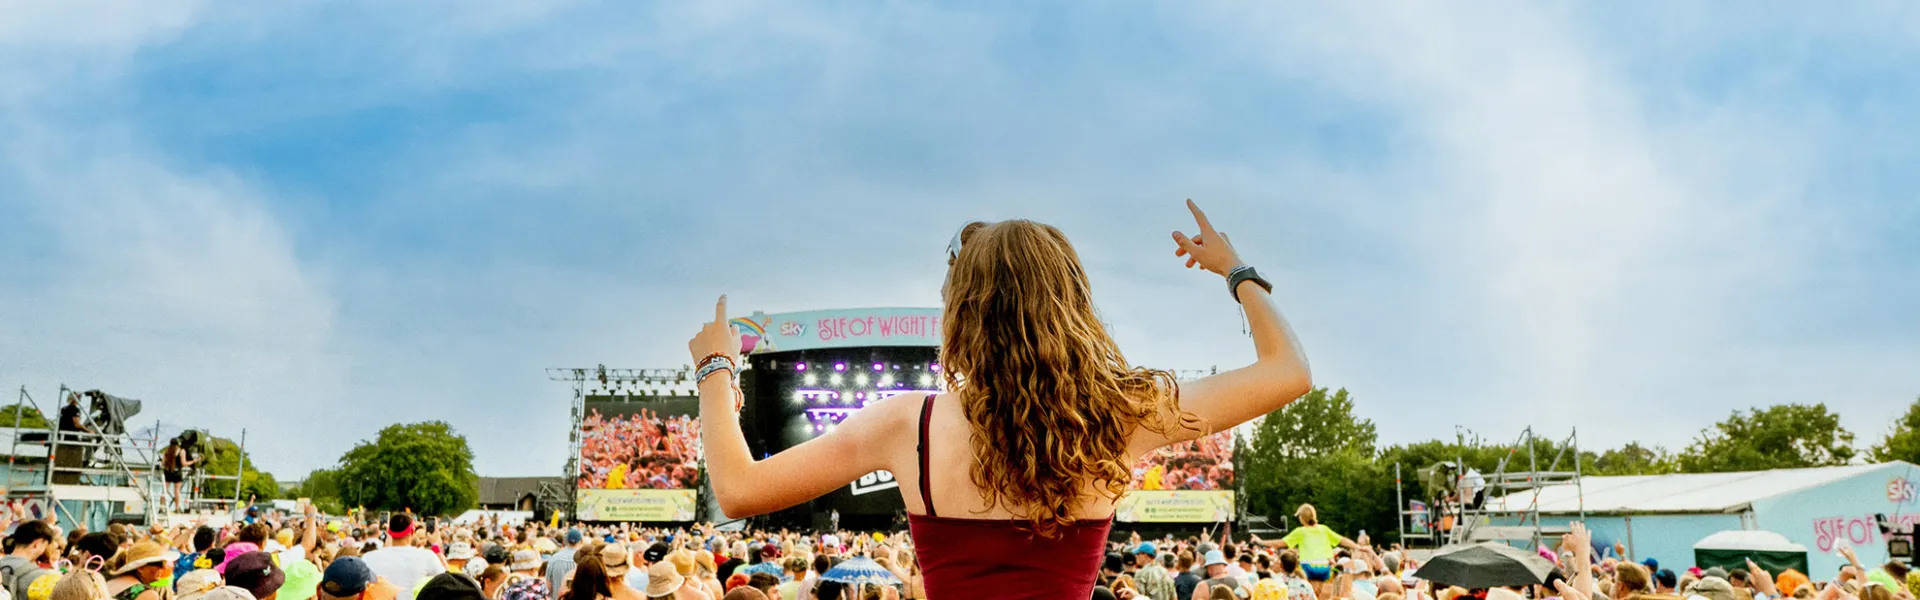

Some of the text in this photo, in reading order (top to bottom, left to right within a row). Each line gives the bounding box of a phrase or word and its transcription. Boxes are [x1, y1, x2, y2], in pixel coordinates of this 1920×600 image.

[780, 322, 807, 337] sky
[818, 318, 847, 341] ISLE
[849, 316, 875, 337] OF
[878, 315, 927, 338] WIGHT
[1887, 477, 1917, 503] sky
[1847, 515, 1875, 545] OF
